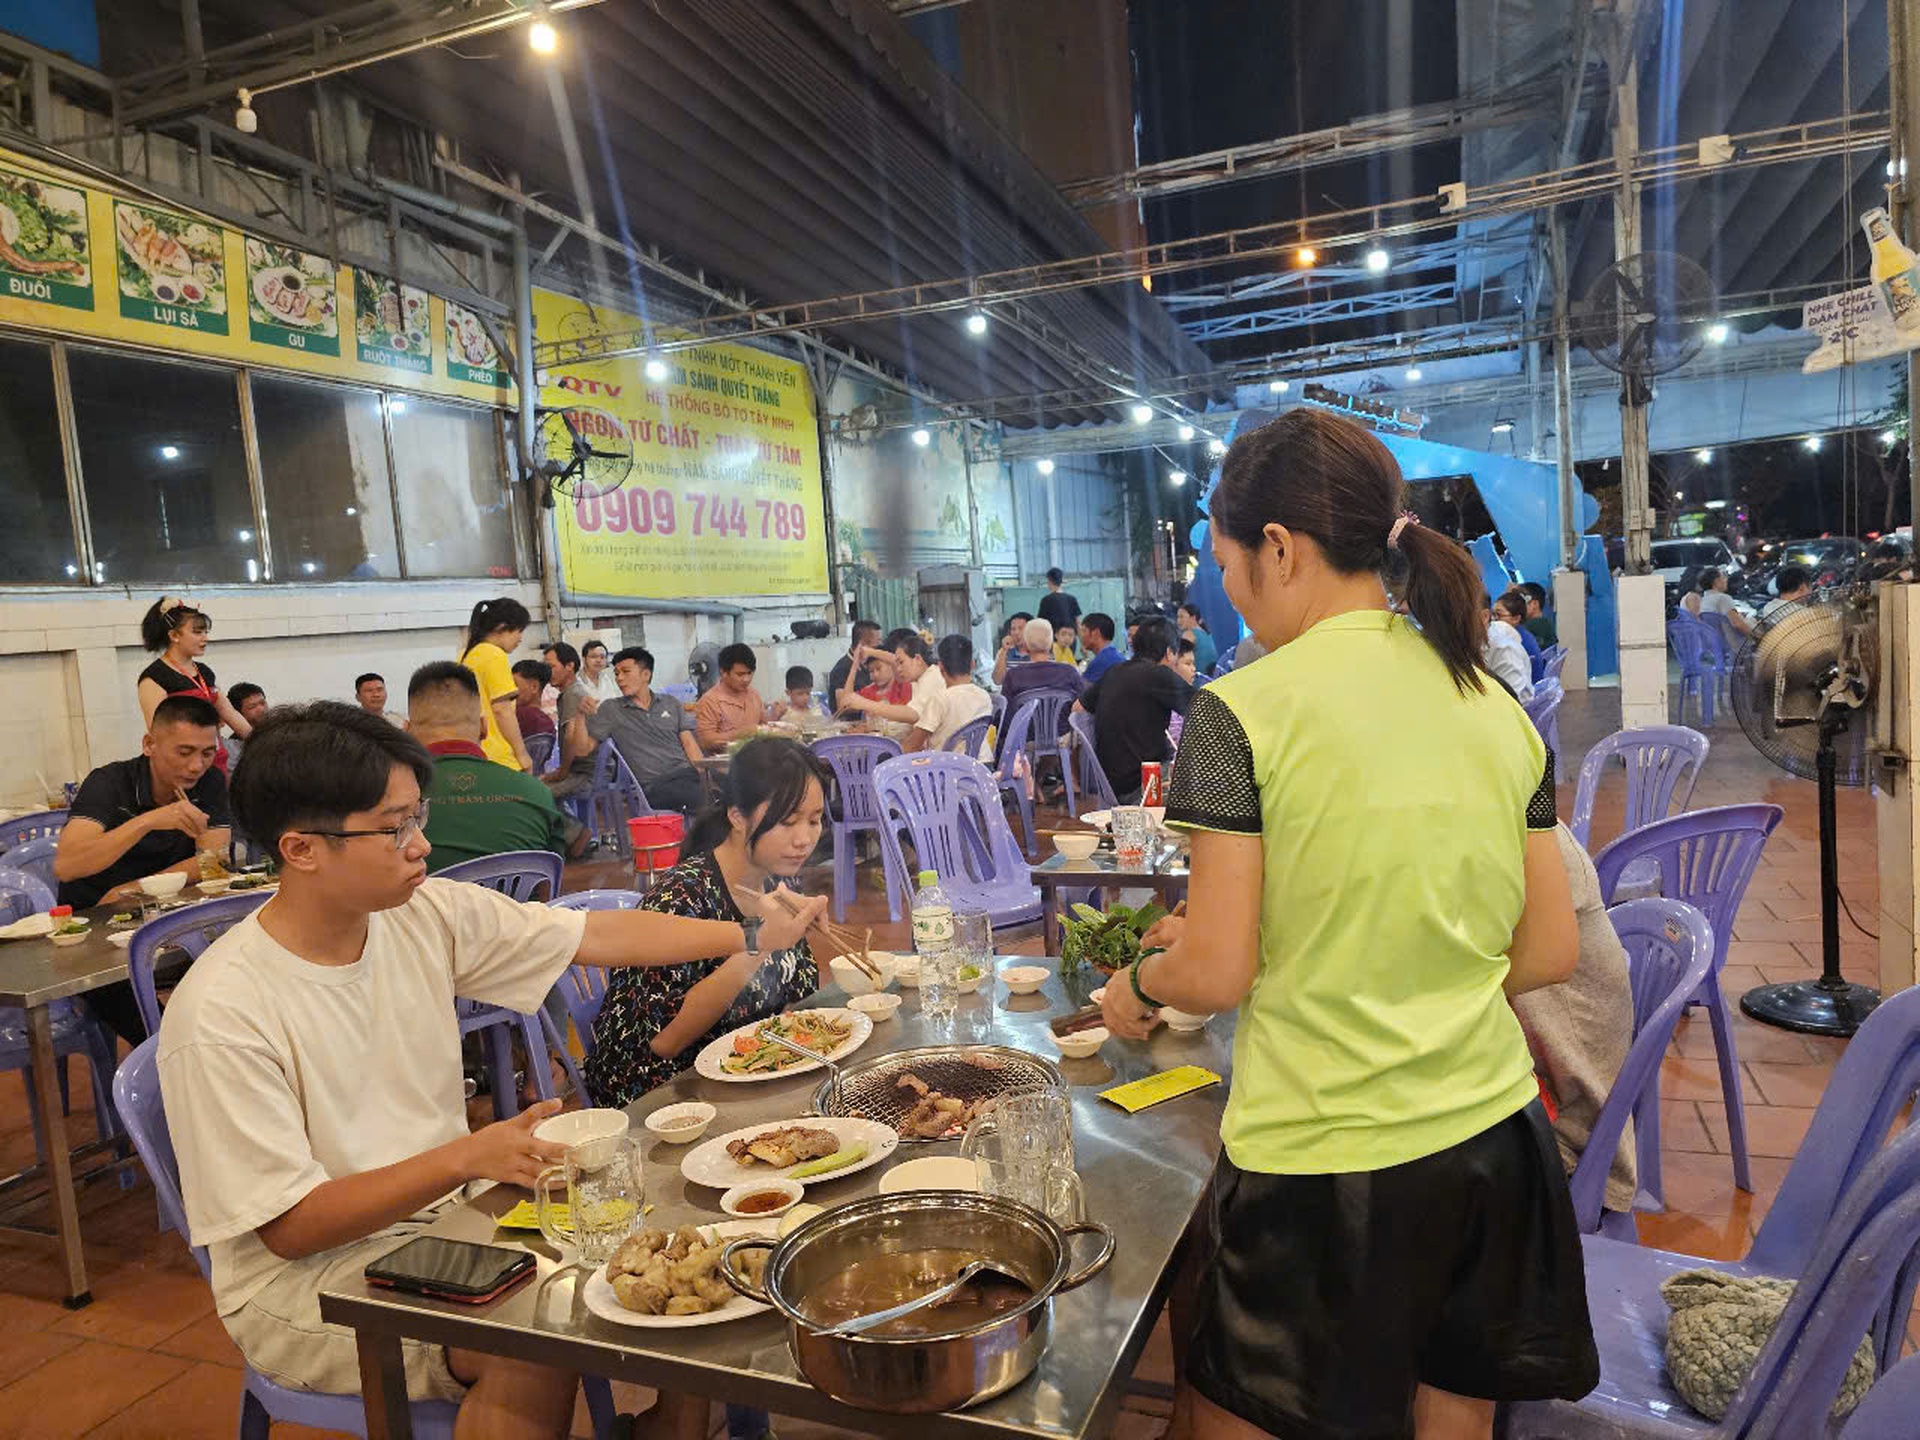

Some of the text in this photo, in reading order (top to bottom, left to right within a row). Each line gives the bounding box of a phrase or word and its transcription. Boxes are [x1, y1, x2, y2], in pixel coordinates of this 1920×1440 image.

[9, 277, 51, 299] ĐUÔI
[1837, 290, 1875, 306] CHILL
[153, 306, 176, 324] LỤI
[288, 333, 306, 347] GU
[564, 375, 622, 398] QTV
[657, 420, 699, 450] CHẤT
[574, 482, 807, 541] 0909 744 789
